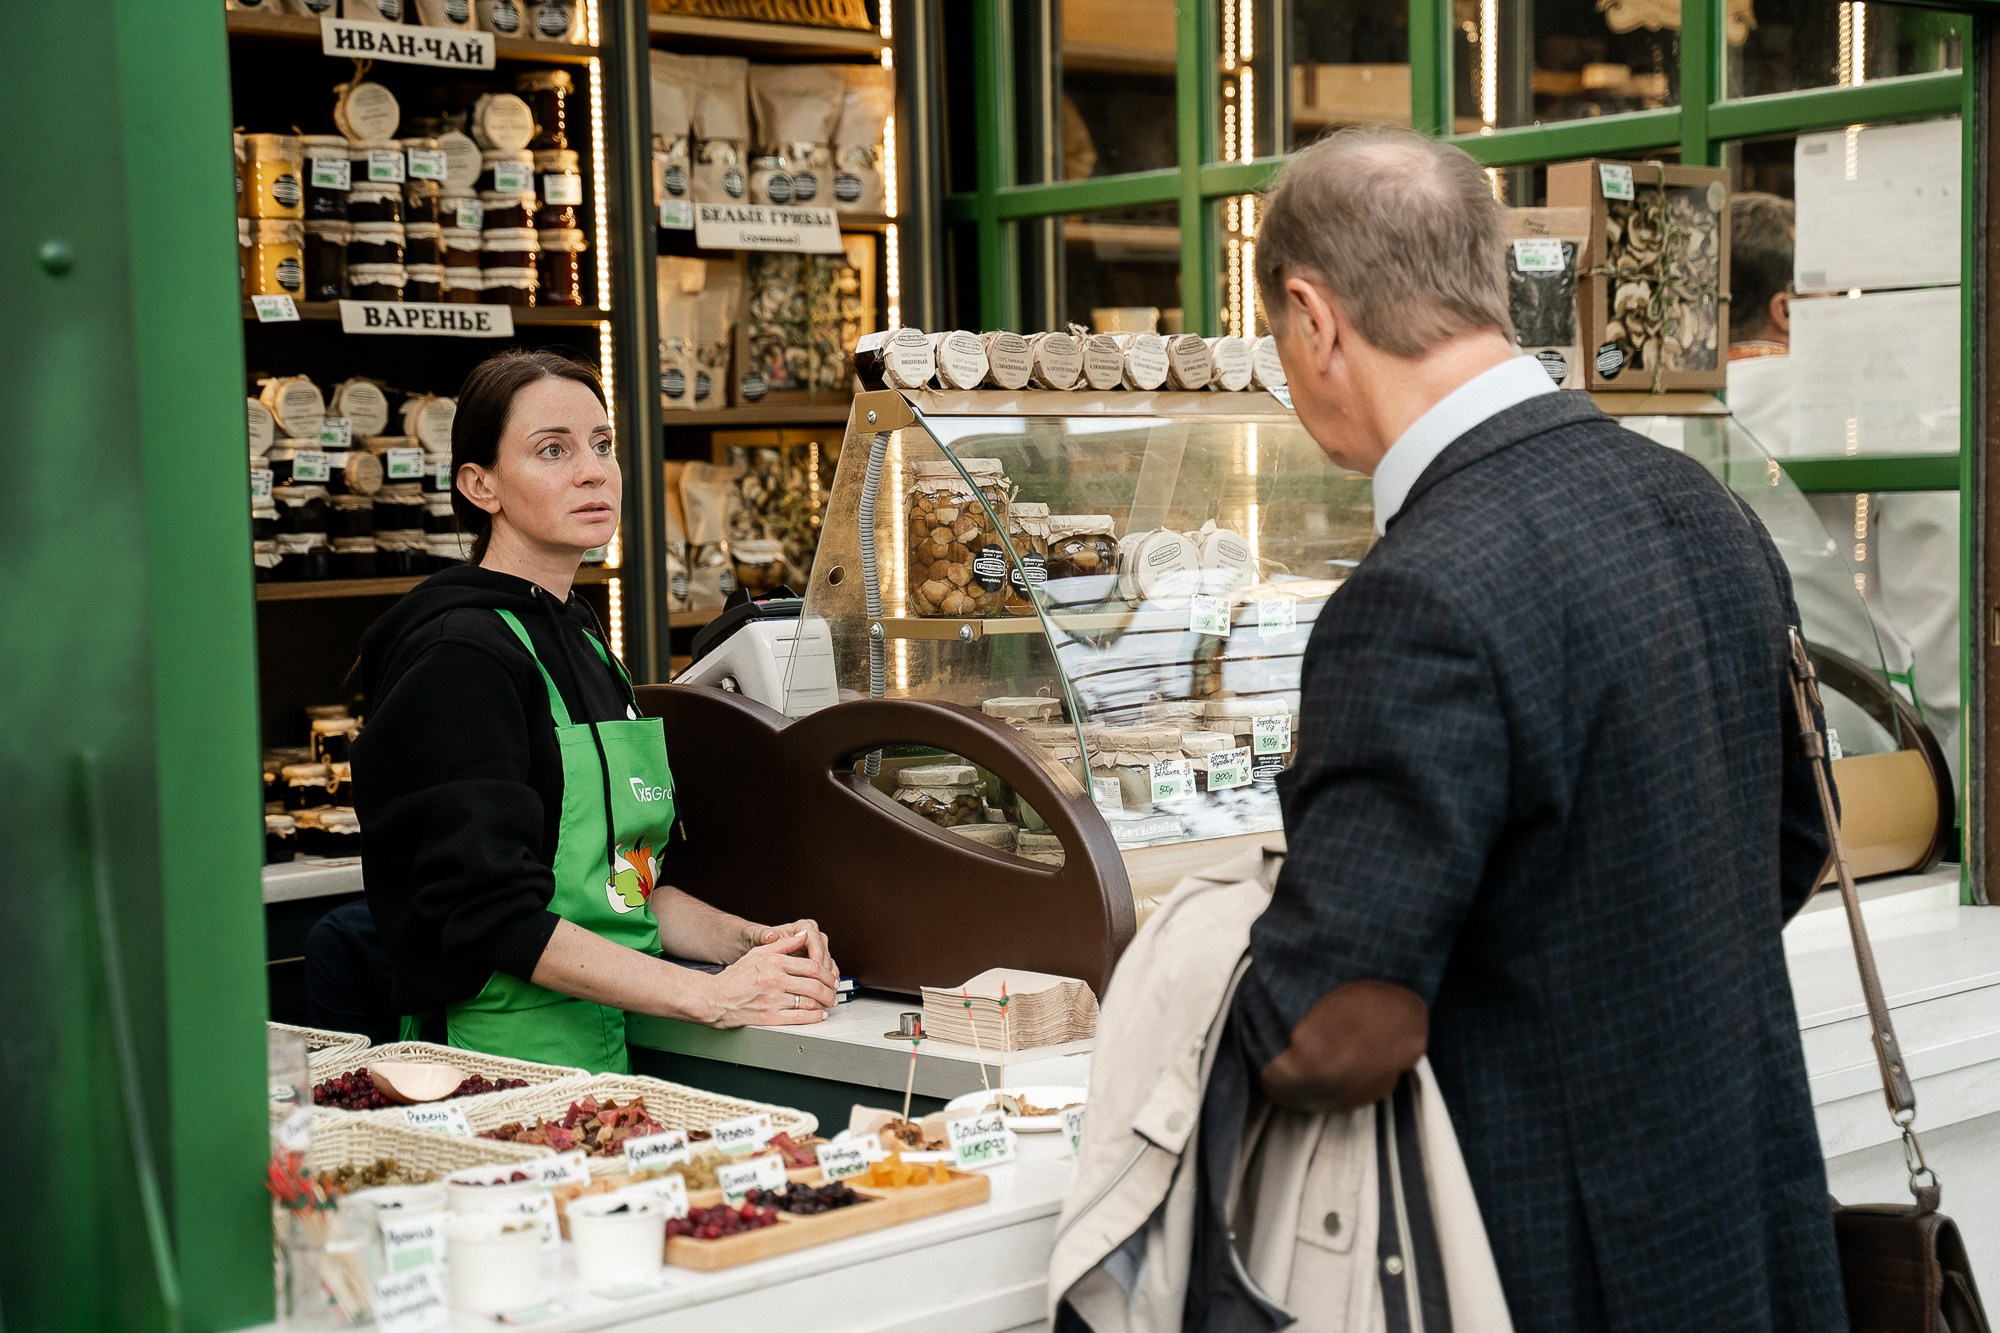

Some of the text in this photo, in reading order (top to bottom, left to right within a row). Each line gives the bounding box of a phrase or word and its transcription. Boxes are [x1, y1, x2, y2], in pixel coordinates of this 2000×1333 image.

[334, 27, 484, 65] ИВАН-ЧАЙ
[364, 306, 493, 332] ВАРЕНЬЕ
[1214, 771, 1233, 783] 900р
[1159, 784, 1174, 795] 500р
[407, 1110, 449, 1125] Ревень
[715, 1127, 755, 1142] Ревень
[953, 1119, 1005, 1141] Грибная
[962, 1138, 1001, 1158] икра
